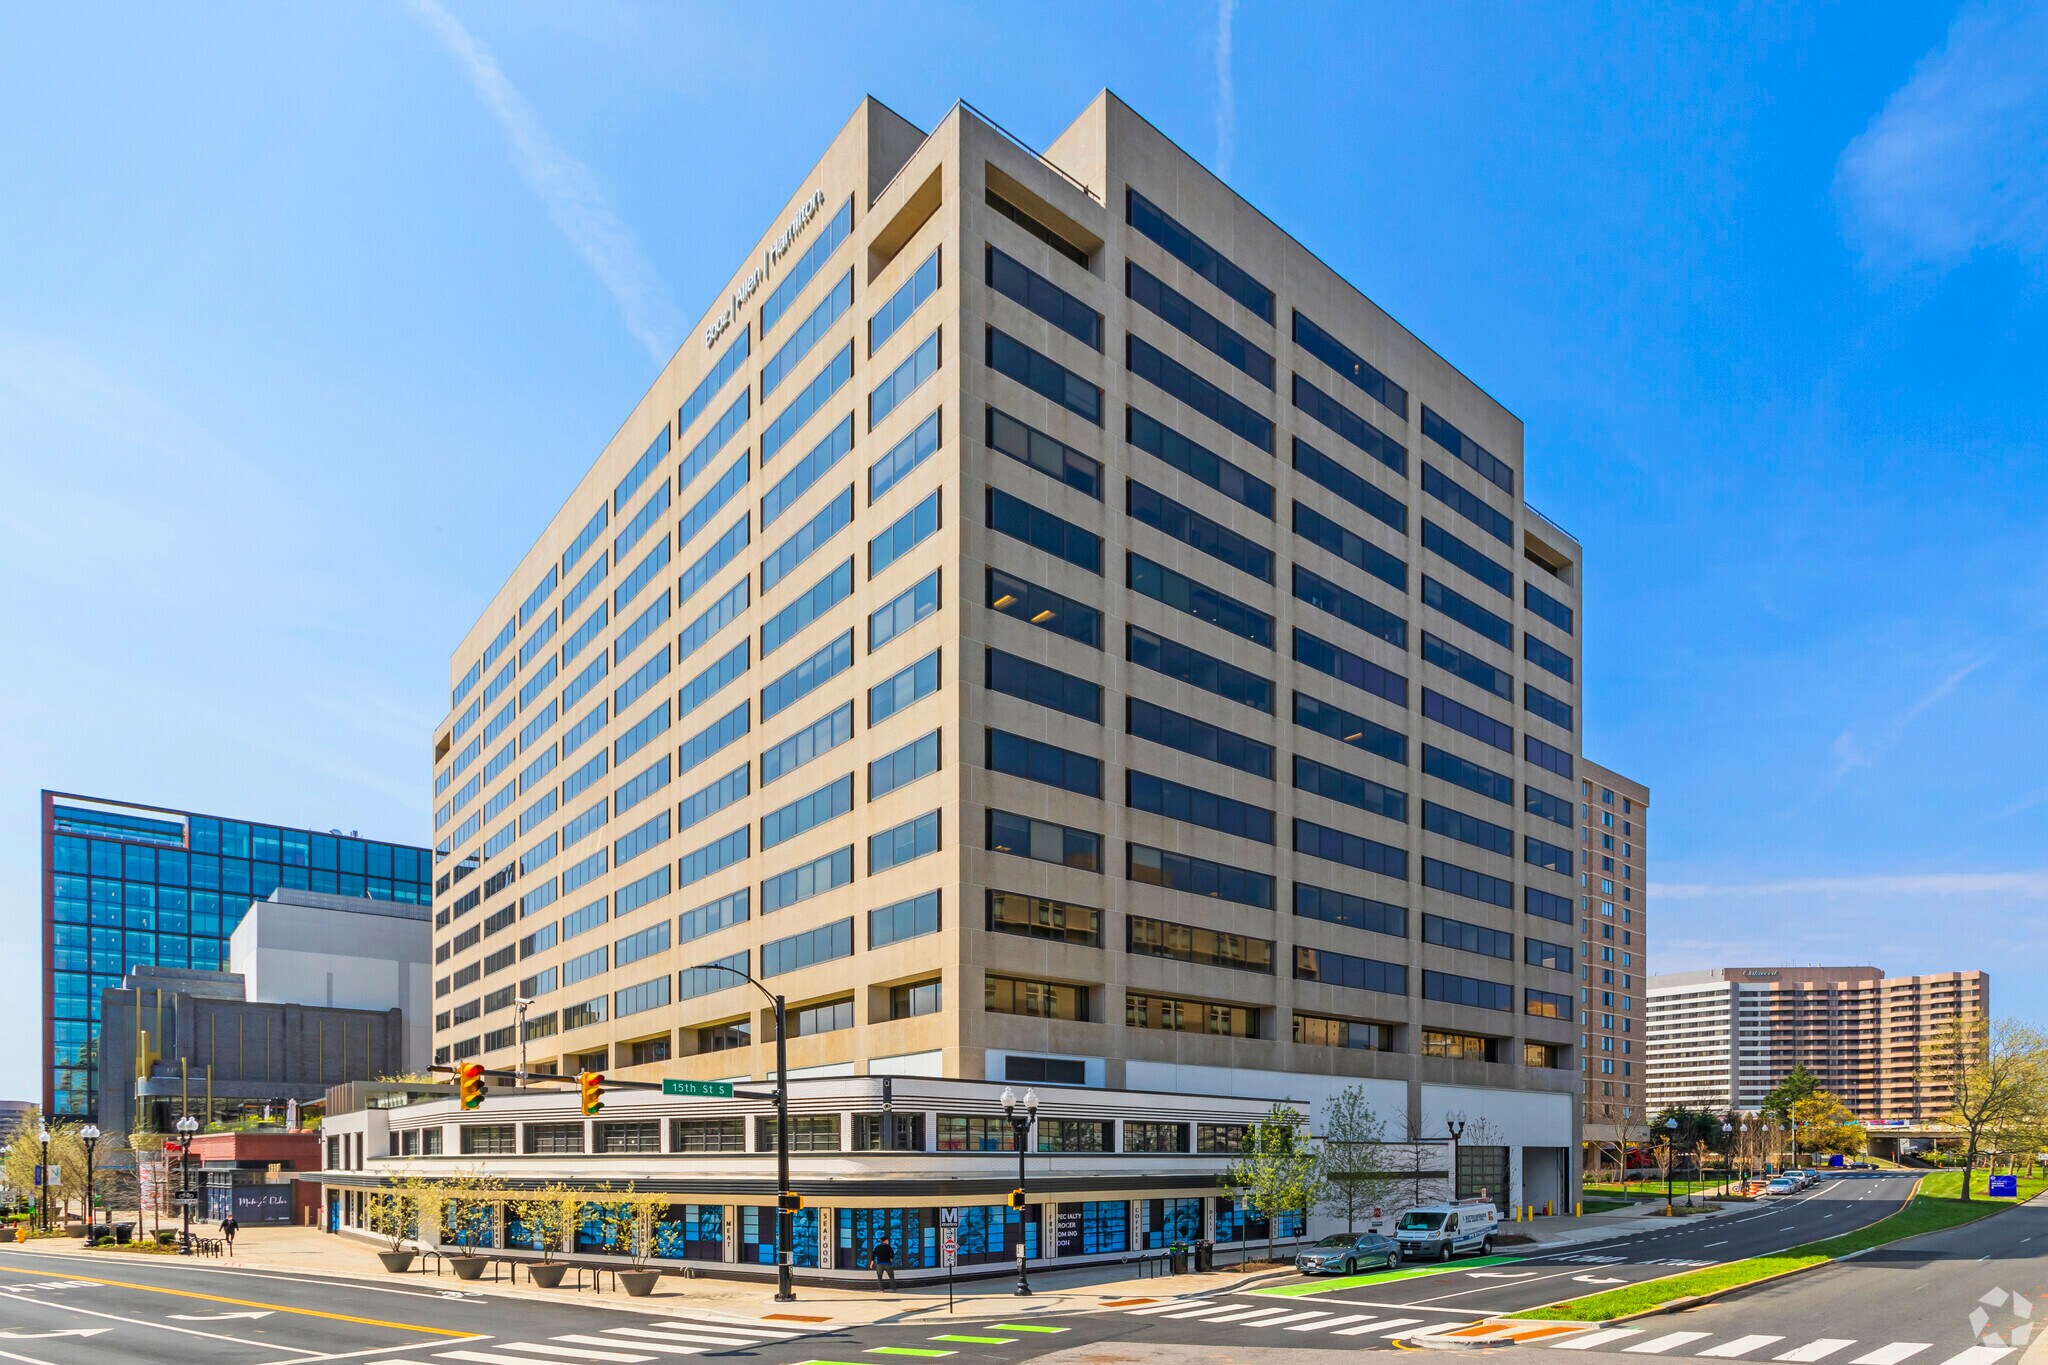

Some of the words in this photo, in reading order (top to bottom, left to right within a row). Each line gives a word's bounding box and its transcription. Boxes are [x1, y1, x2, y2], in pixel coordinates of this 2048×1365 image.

[705, 308, 730, 347] Booz
[736, 267, 762, 306] Allen
[770, 188, 821, 263] Hamilton
[672, 1083, 696, 1093] 15th
[702, 1084, 713, 1094] St
[719, 1085, 725, 1094] S
[941, 1207, 958, 1222] M
